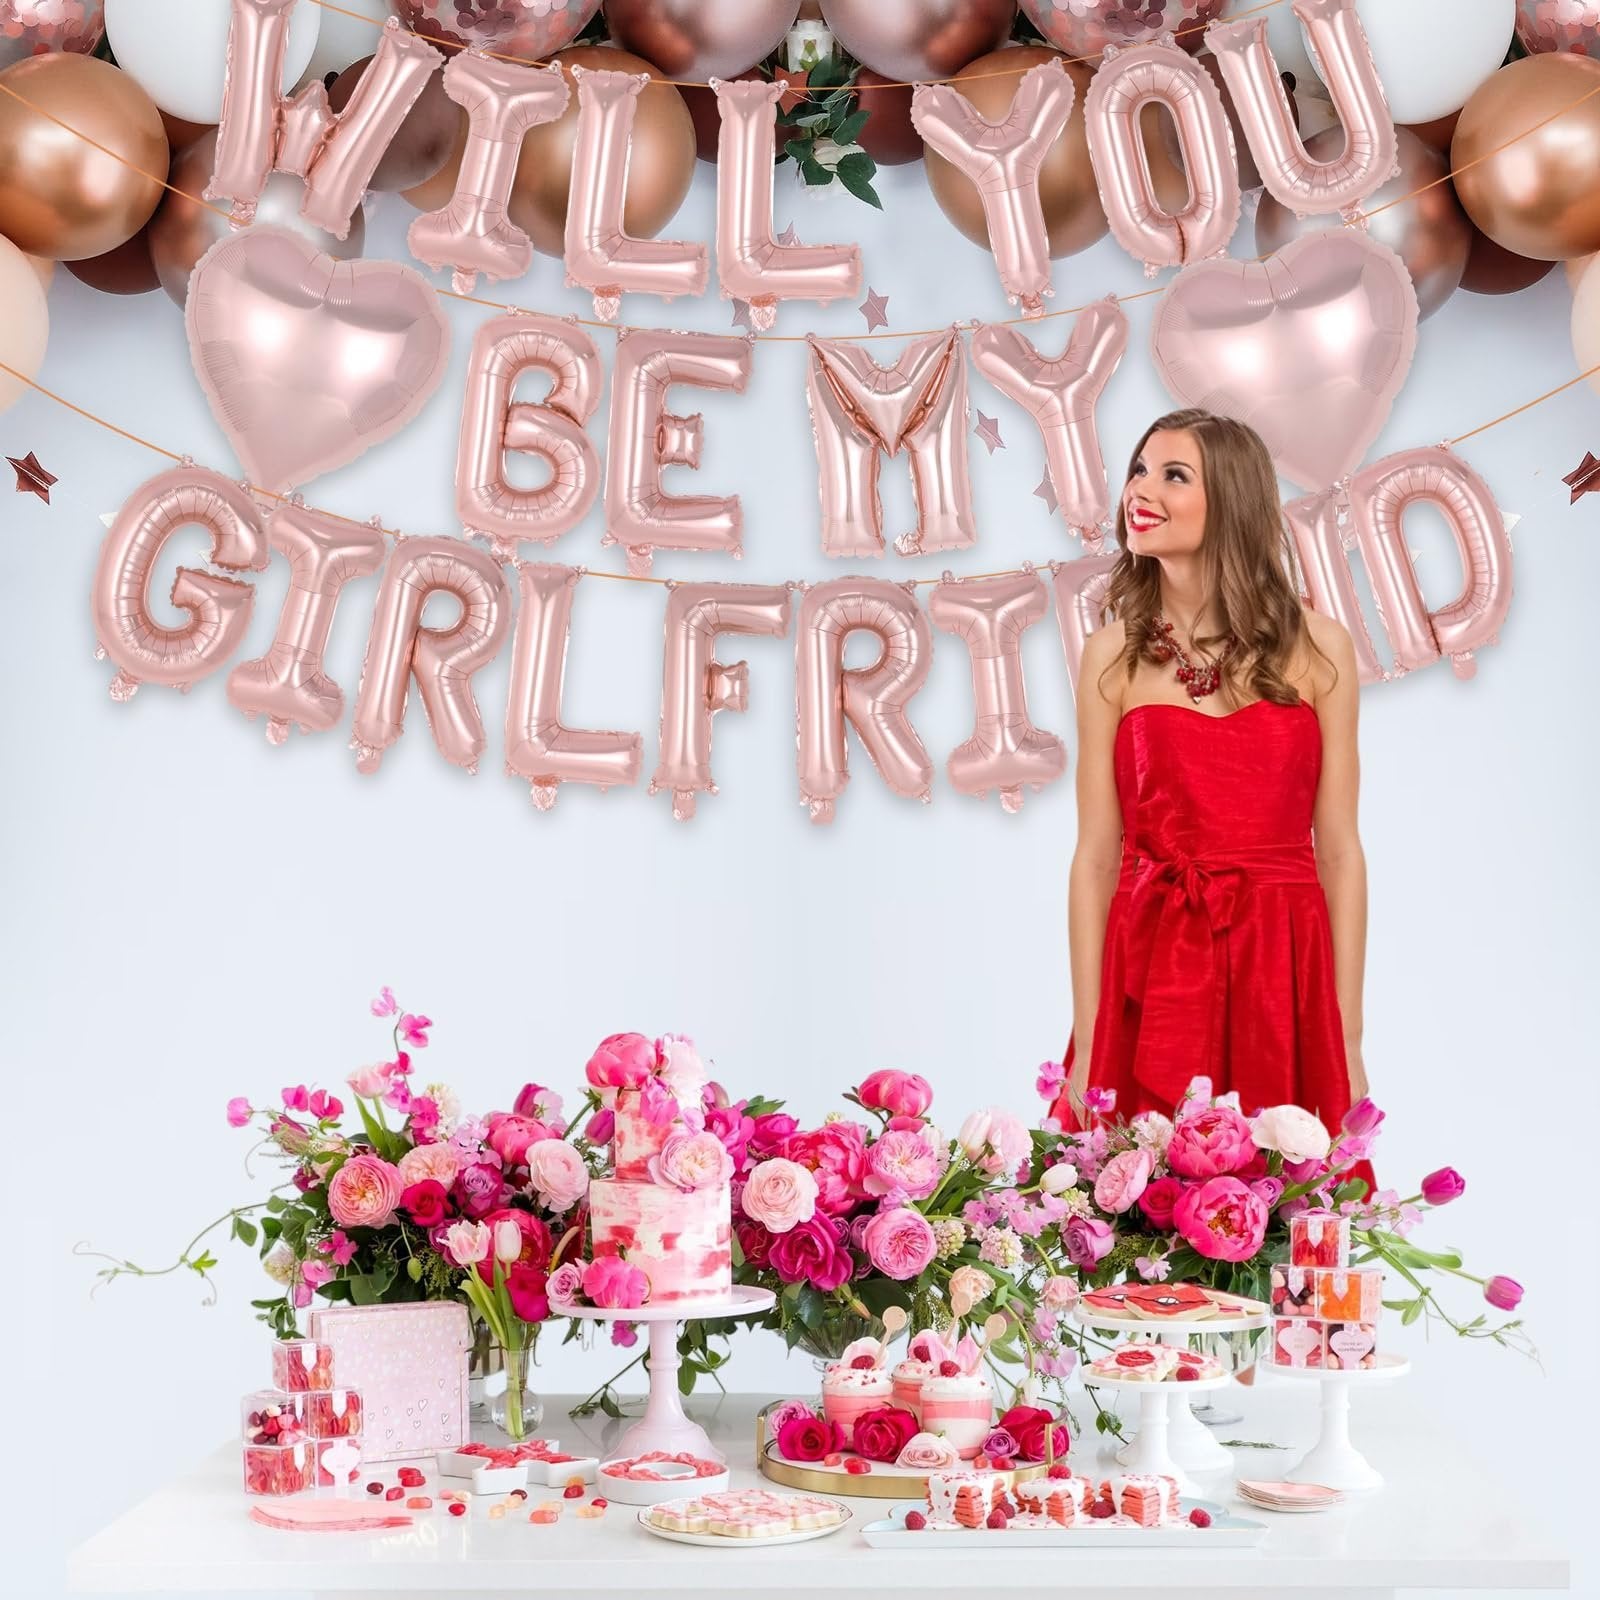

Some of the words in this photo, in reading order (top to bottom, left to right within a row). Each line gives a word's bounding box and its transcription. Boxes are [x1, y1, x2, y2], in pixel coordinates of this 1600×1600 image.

[204, 0, 864, 328] WILL
[911, 0, 1400, 315] YOU
[455, 312, 756, 570] BE
[806, 298, 1130, 557] MY
[91, 460, 1514, 820] GIRLFRID
